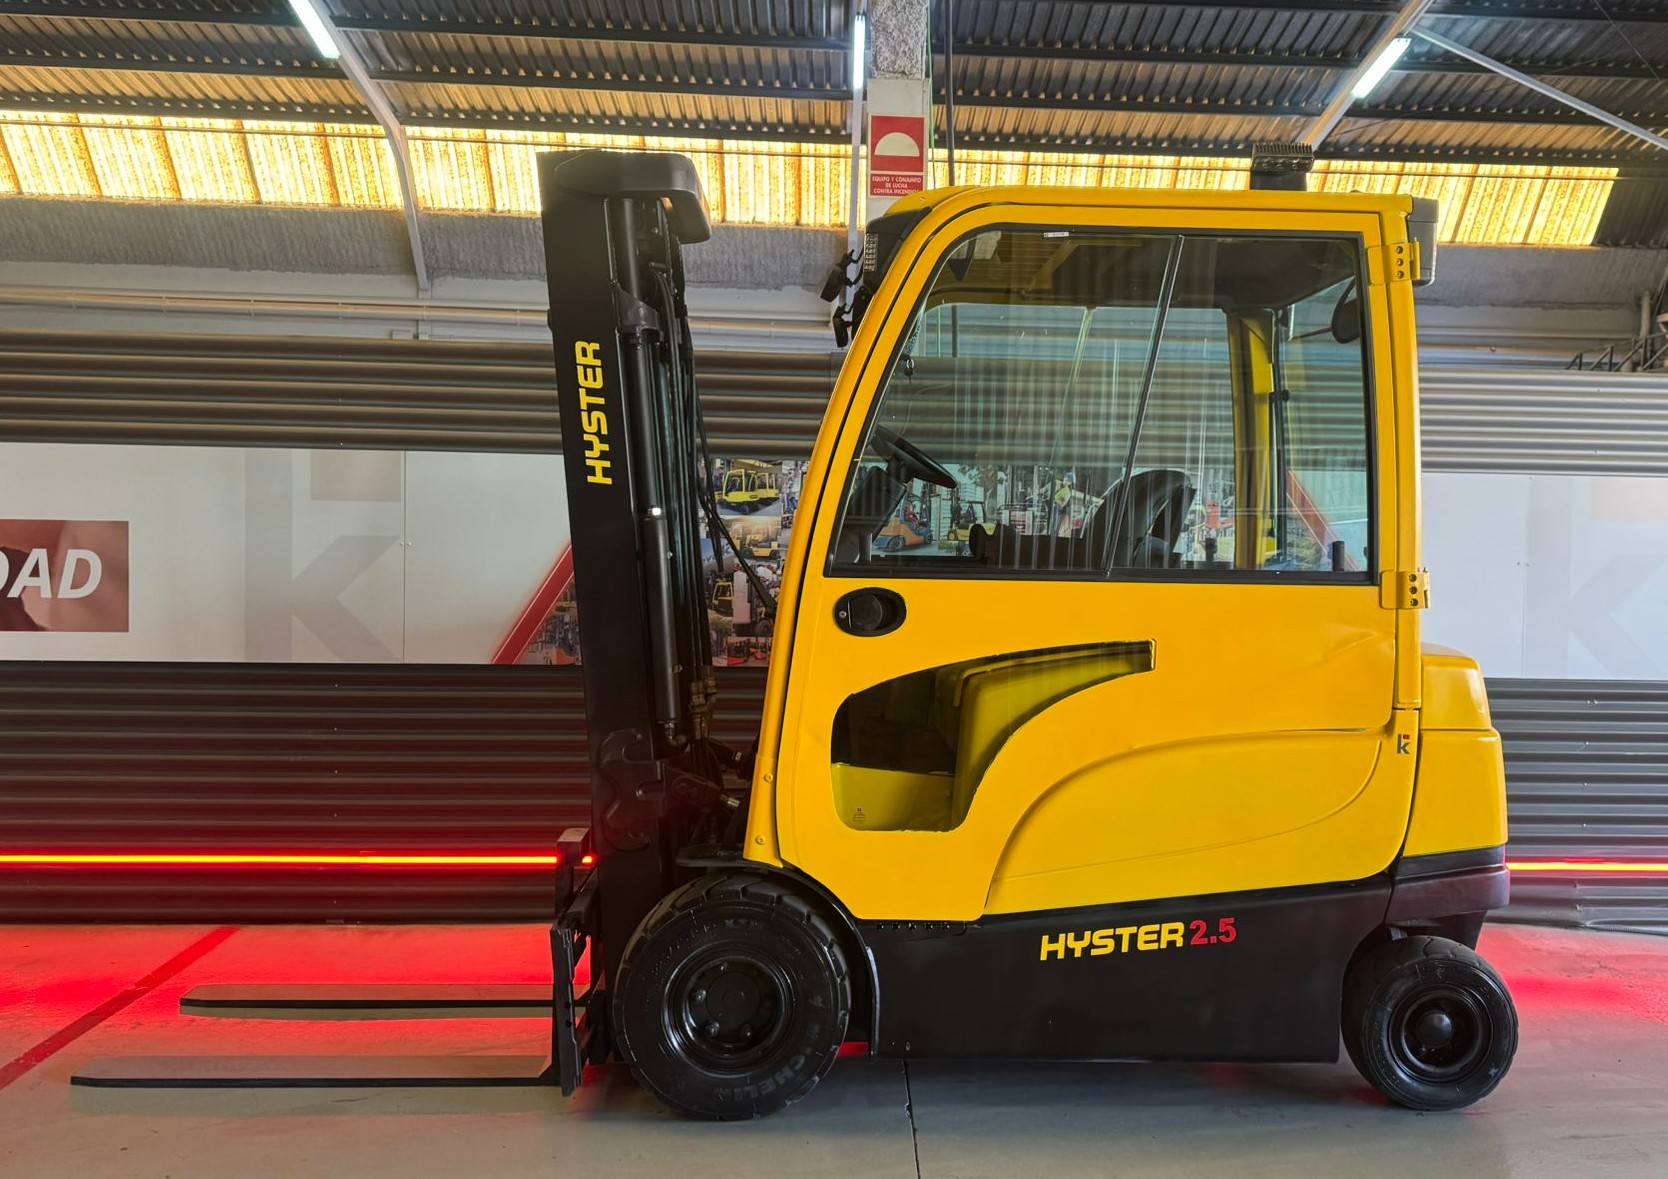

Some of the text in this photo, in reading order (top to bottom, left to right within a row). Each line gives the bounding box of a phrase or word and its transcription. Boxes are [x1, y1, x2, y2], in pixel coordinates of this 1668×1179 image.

[575, 341, 613, 485] HYSTER
[0, 548, 103, 599] AD
[1040, 917, 1237, 961] HYSTER 2.5
